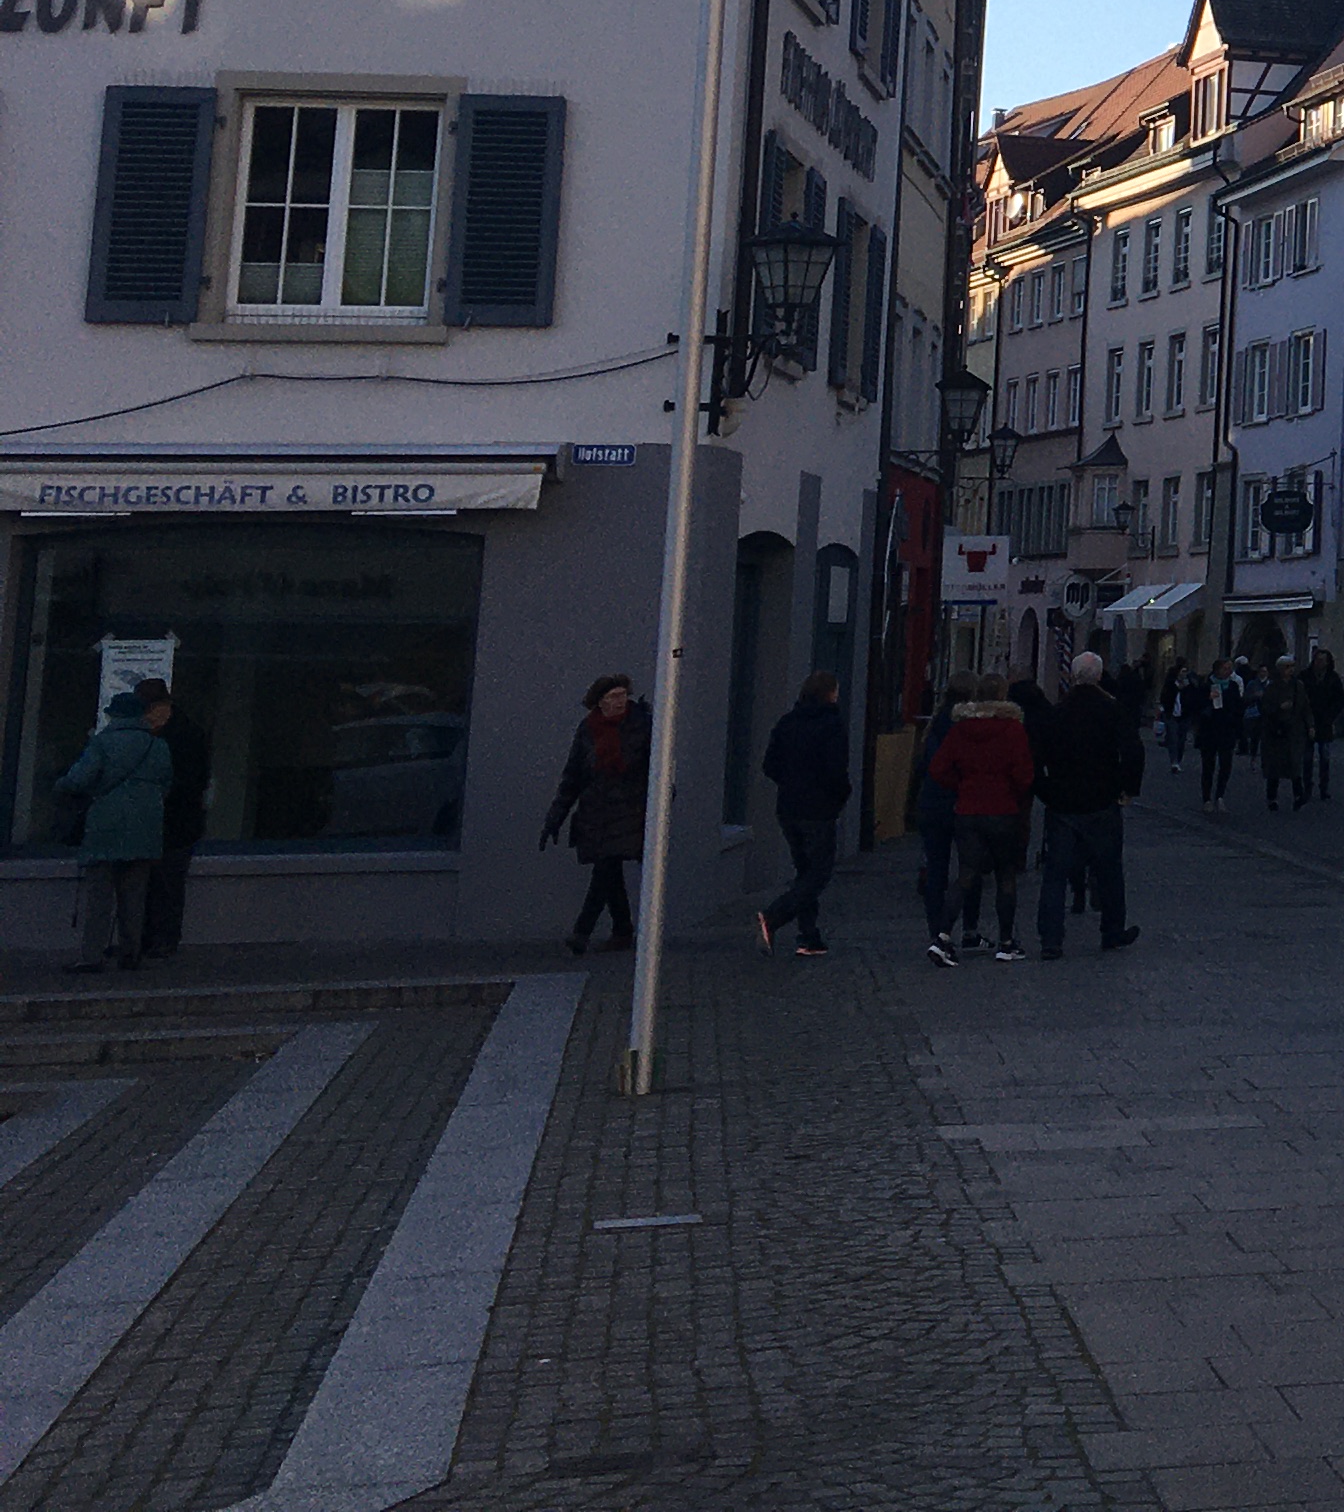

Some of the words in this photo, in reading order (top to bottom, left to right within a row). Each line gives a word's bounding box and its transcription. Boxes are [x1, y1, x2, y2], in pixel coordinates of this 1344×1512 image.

[577, 447, 630, 462] Hofstatt
[38, 480, 274, 506] FISCHGESCHÄFT
[286, 484, 307, 505] &
[332, 483, 435, 505] BISTRO
